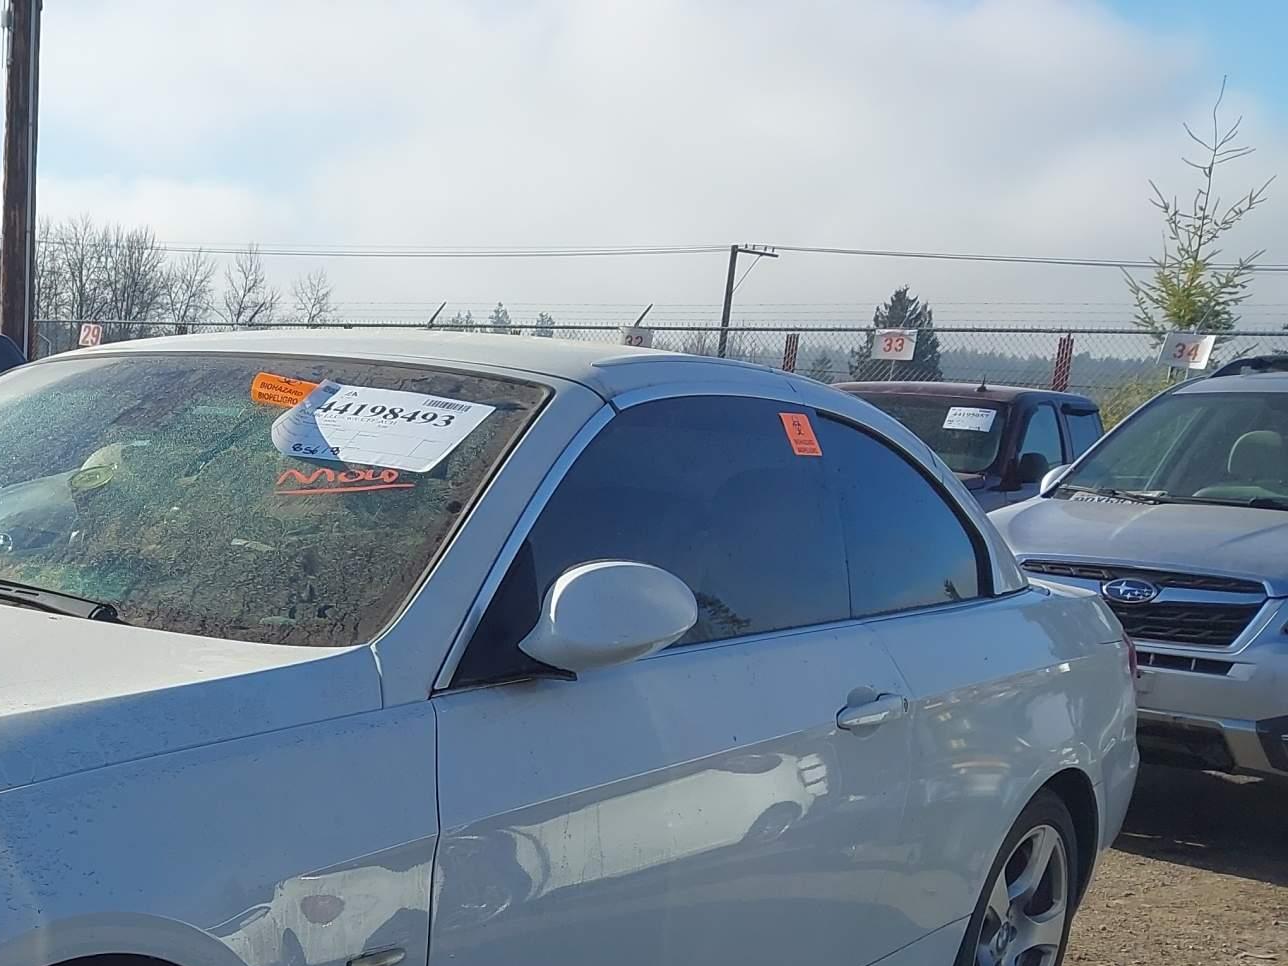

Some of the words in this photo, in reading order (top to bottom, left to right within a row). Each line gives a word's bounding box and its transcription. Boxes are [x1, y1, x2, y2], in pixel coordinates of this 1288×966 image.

[81, 325, 100, 345] 29
[882, 337, 905, 353] 33
[1172, 342, 1200, 361] 34
[259, 381, 304, 397] BIOHAZARD
[257, 391, 299, 405] BIOPELIGRO
[316, 400, 455, 427] 44198493
